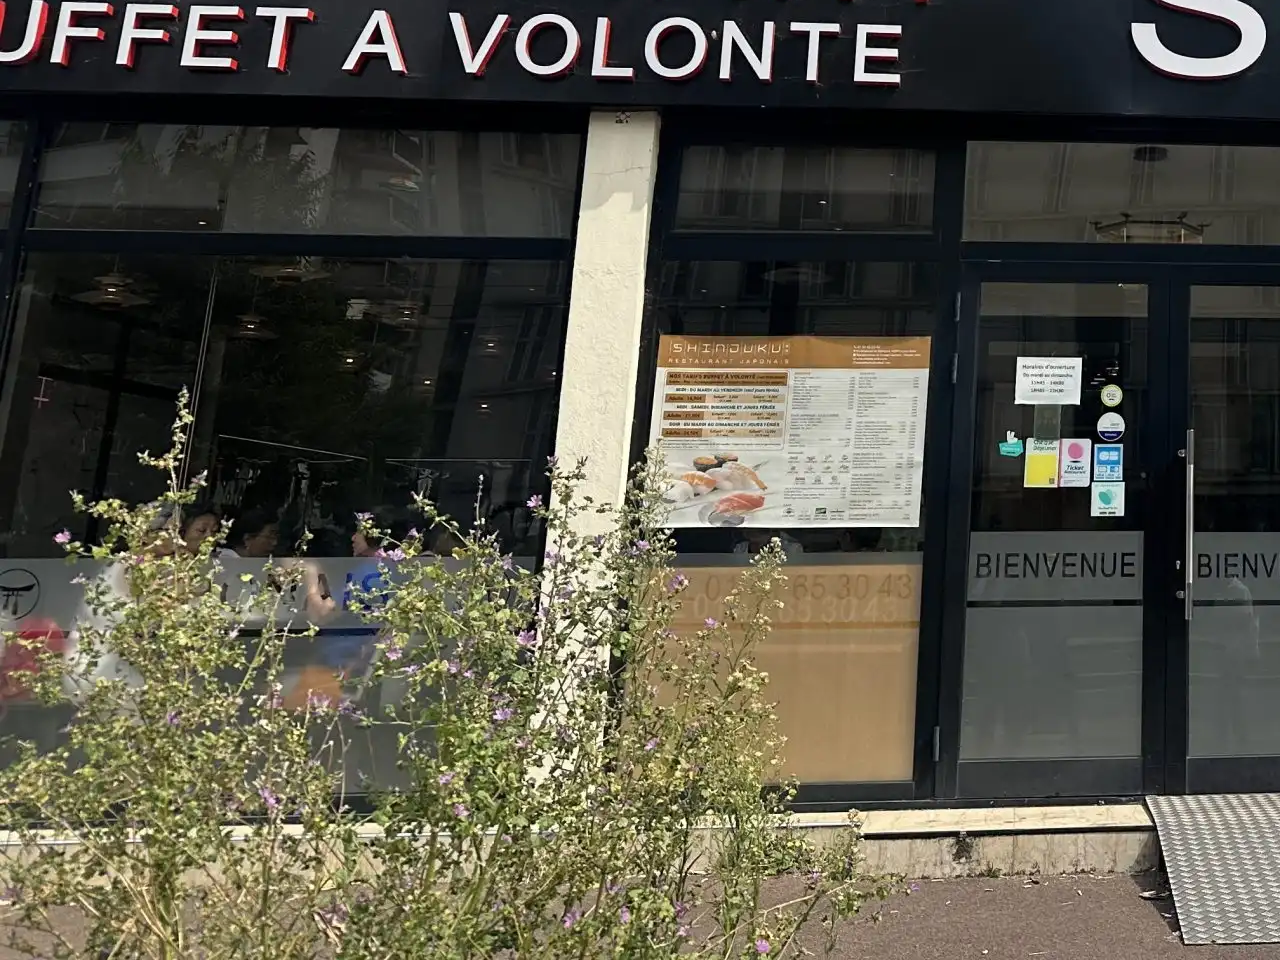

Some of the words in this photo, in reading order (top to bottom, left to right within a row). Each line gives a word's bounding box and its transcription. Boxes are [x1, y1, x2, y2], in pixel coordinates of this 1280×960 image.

[341, 9, 408, 75] A
[449, 11, 902, 85] VOLONTE
[975, 552, 1136, 579] BIENVENUE
[792, 573, 825, 600] 65
[835, 573, 869, 600] 30
[878, 572, 913, 600] 43
